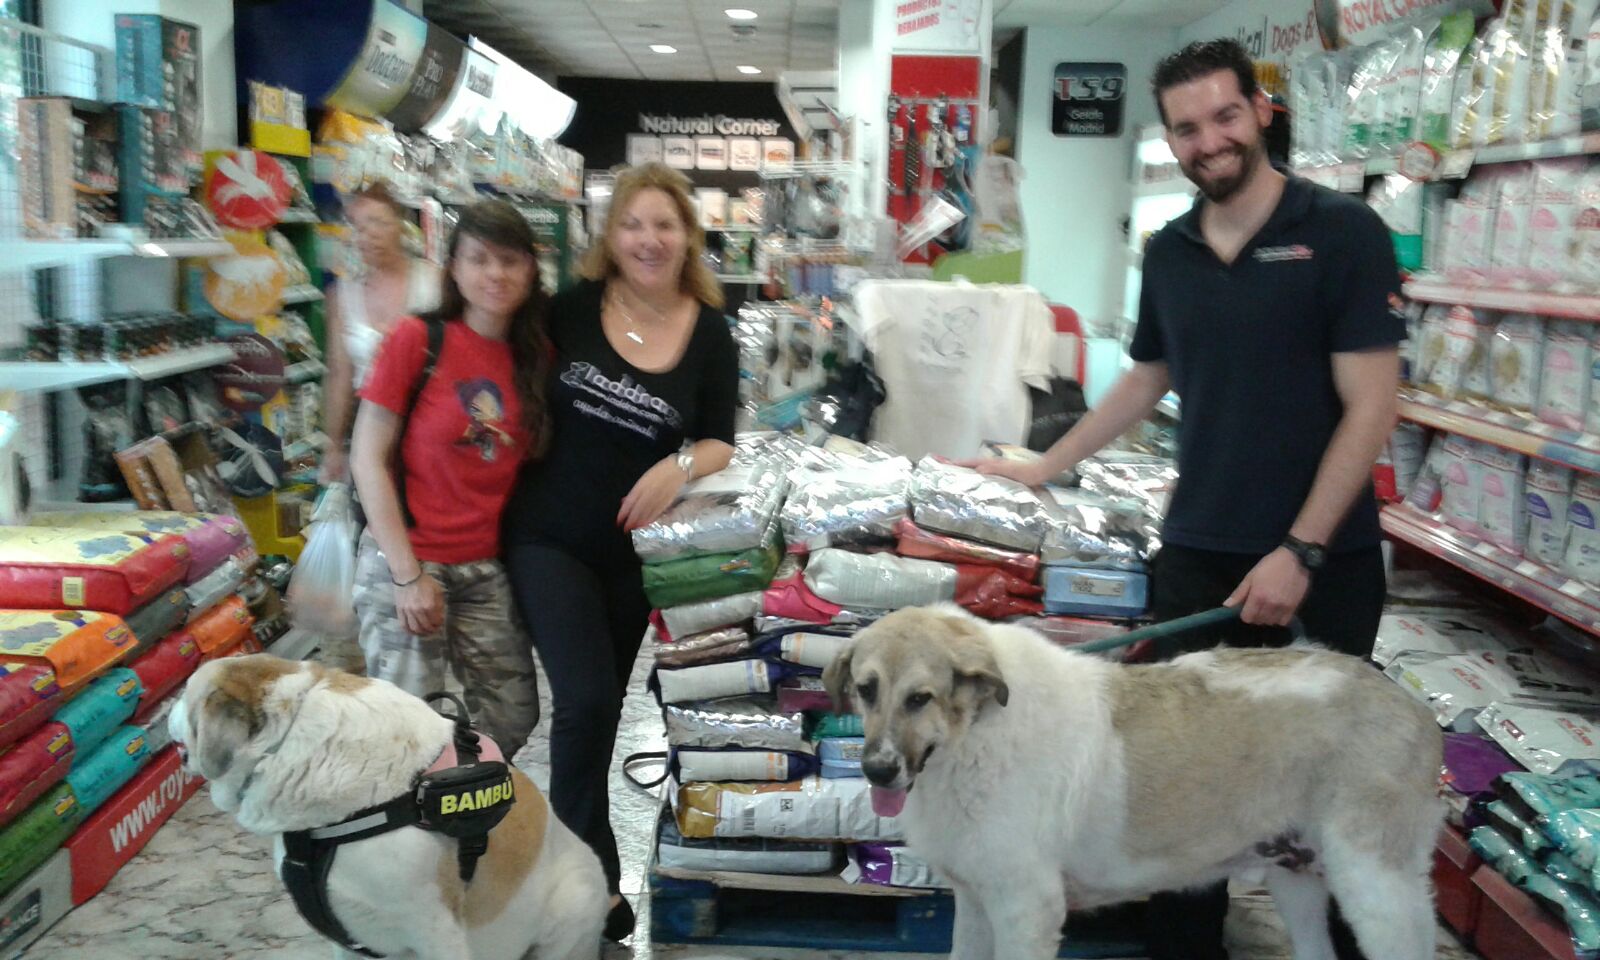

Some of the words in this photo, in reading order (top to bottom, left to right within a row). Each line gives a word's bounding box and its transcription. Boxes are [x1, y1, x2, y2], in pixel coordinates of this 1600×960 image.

[640, 112, 714, 133] Natural
[716, 114, 781, 136] Corner
[441, 776, 513, 815] BAMBÚ
